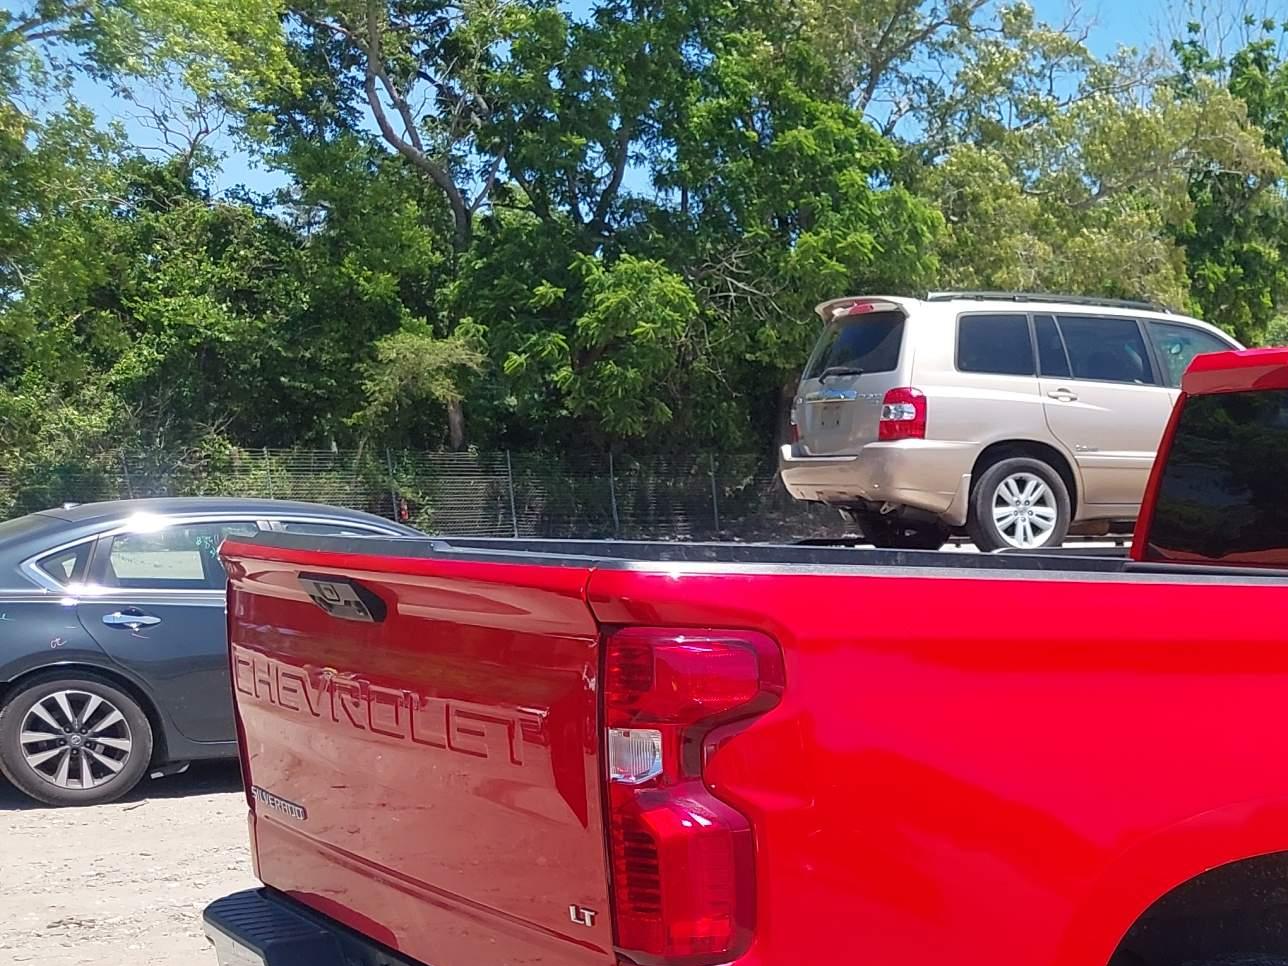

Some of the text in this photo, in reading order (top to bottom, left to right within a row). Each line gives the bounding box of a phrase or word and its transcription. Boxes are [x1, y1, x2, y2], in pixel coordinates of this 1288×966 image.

[234, 651, 549, 766] CHEVROLET
[251, 786, 305, 820] SILVERADO
[569, 905, 596, 927] LT
